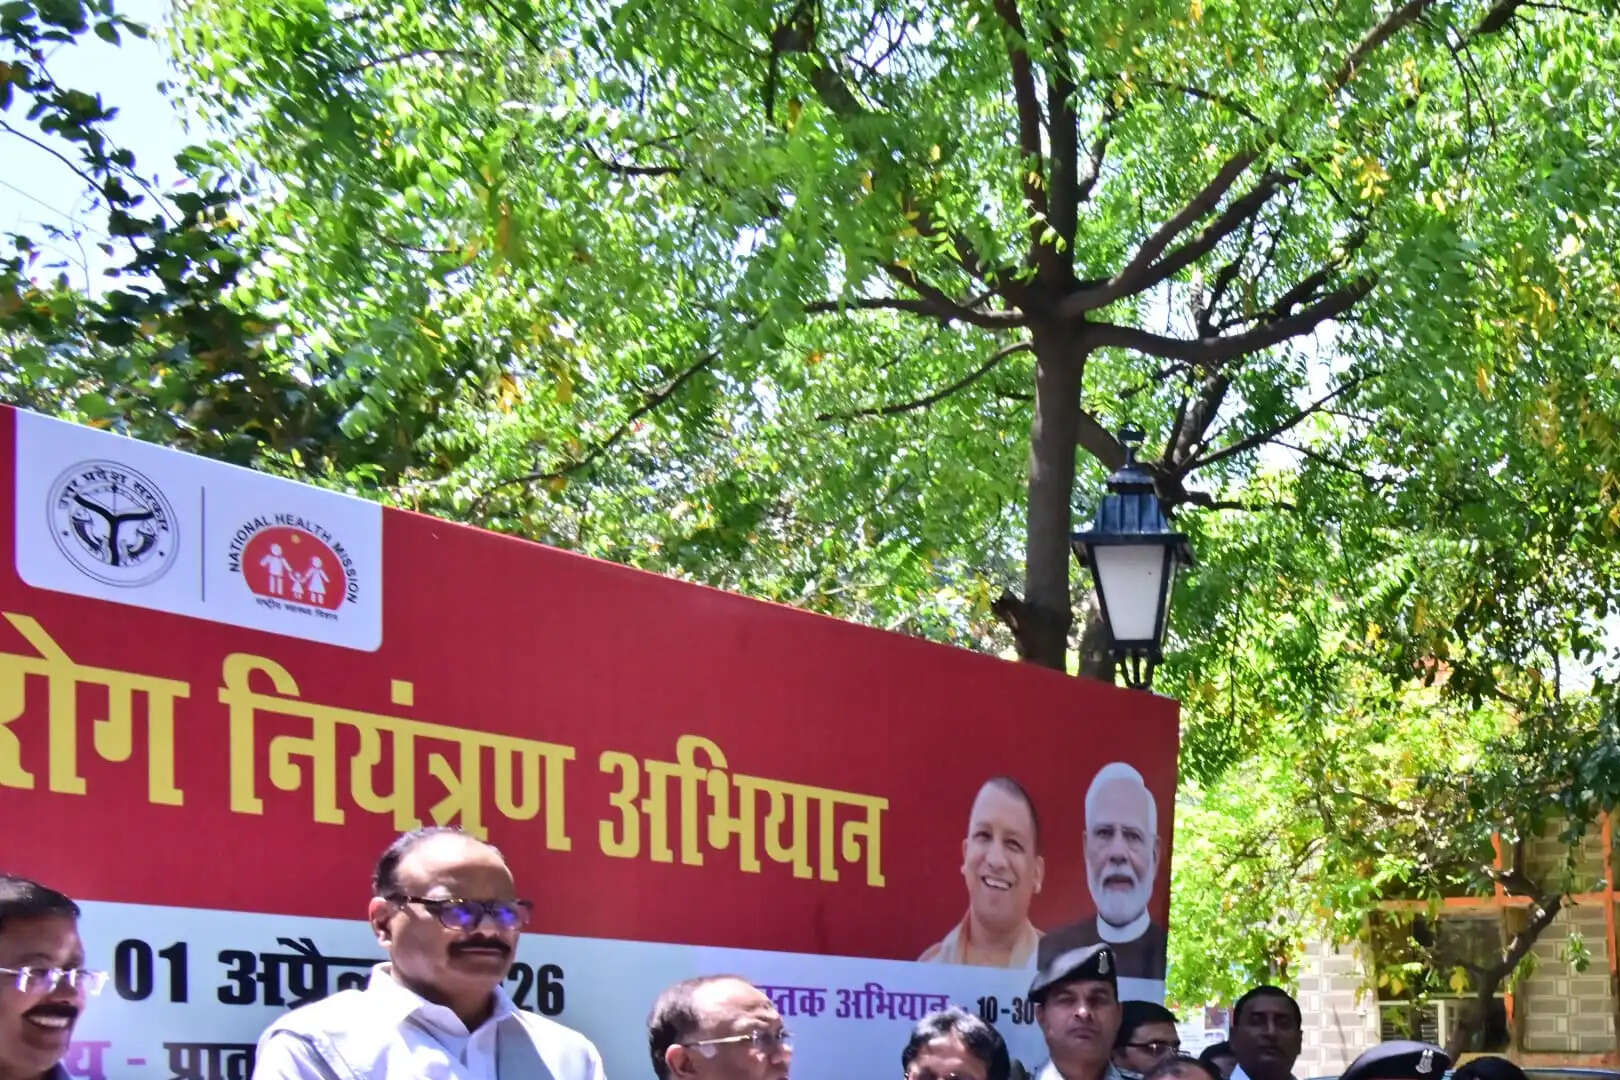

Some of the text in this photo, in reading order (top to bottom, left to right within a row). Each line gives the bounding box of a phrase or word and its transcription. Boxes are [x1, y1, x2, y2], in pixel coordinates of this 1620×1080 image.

[228, 513, 360, 604] NATIONAL HEALTH MISSION
[218, 652, 576, 852] नियंत्रण
[599, 734, 889, 888] अभियान
[114, 938, 190, 1004] 01
